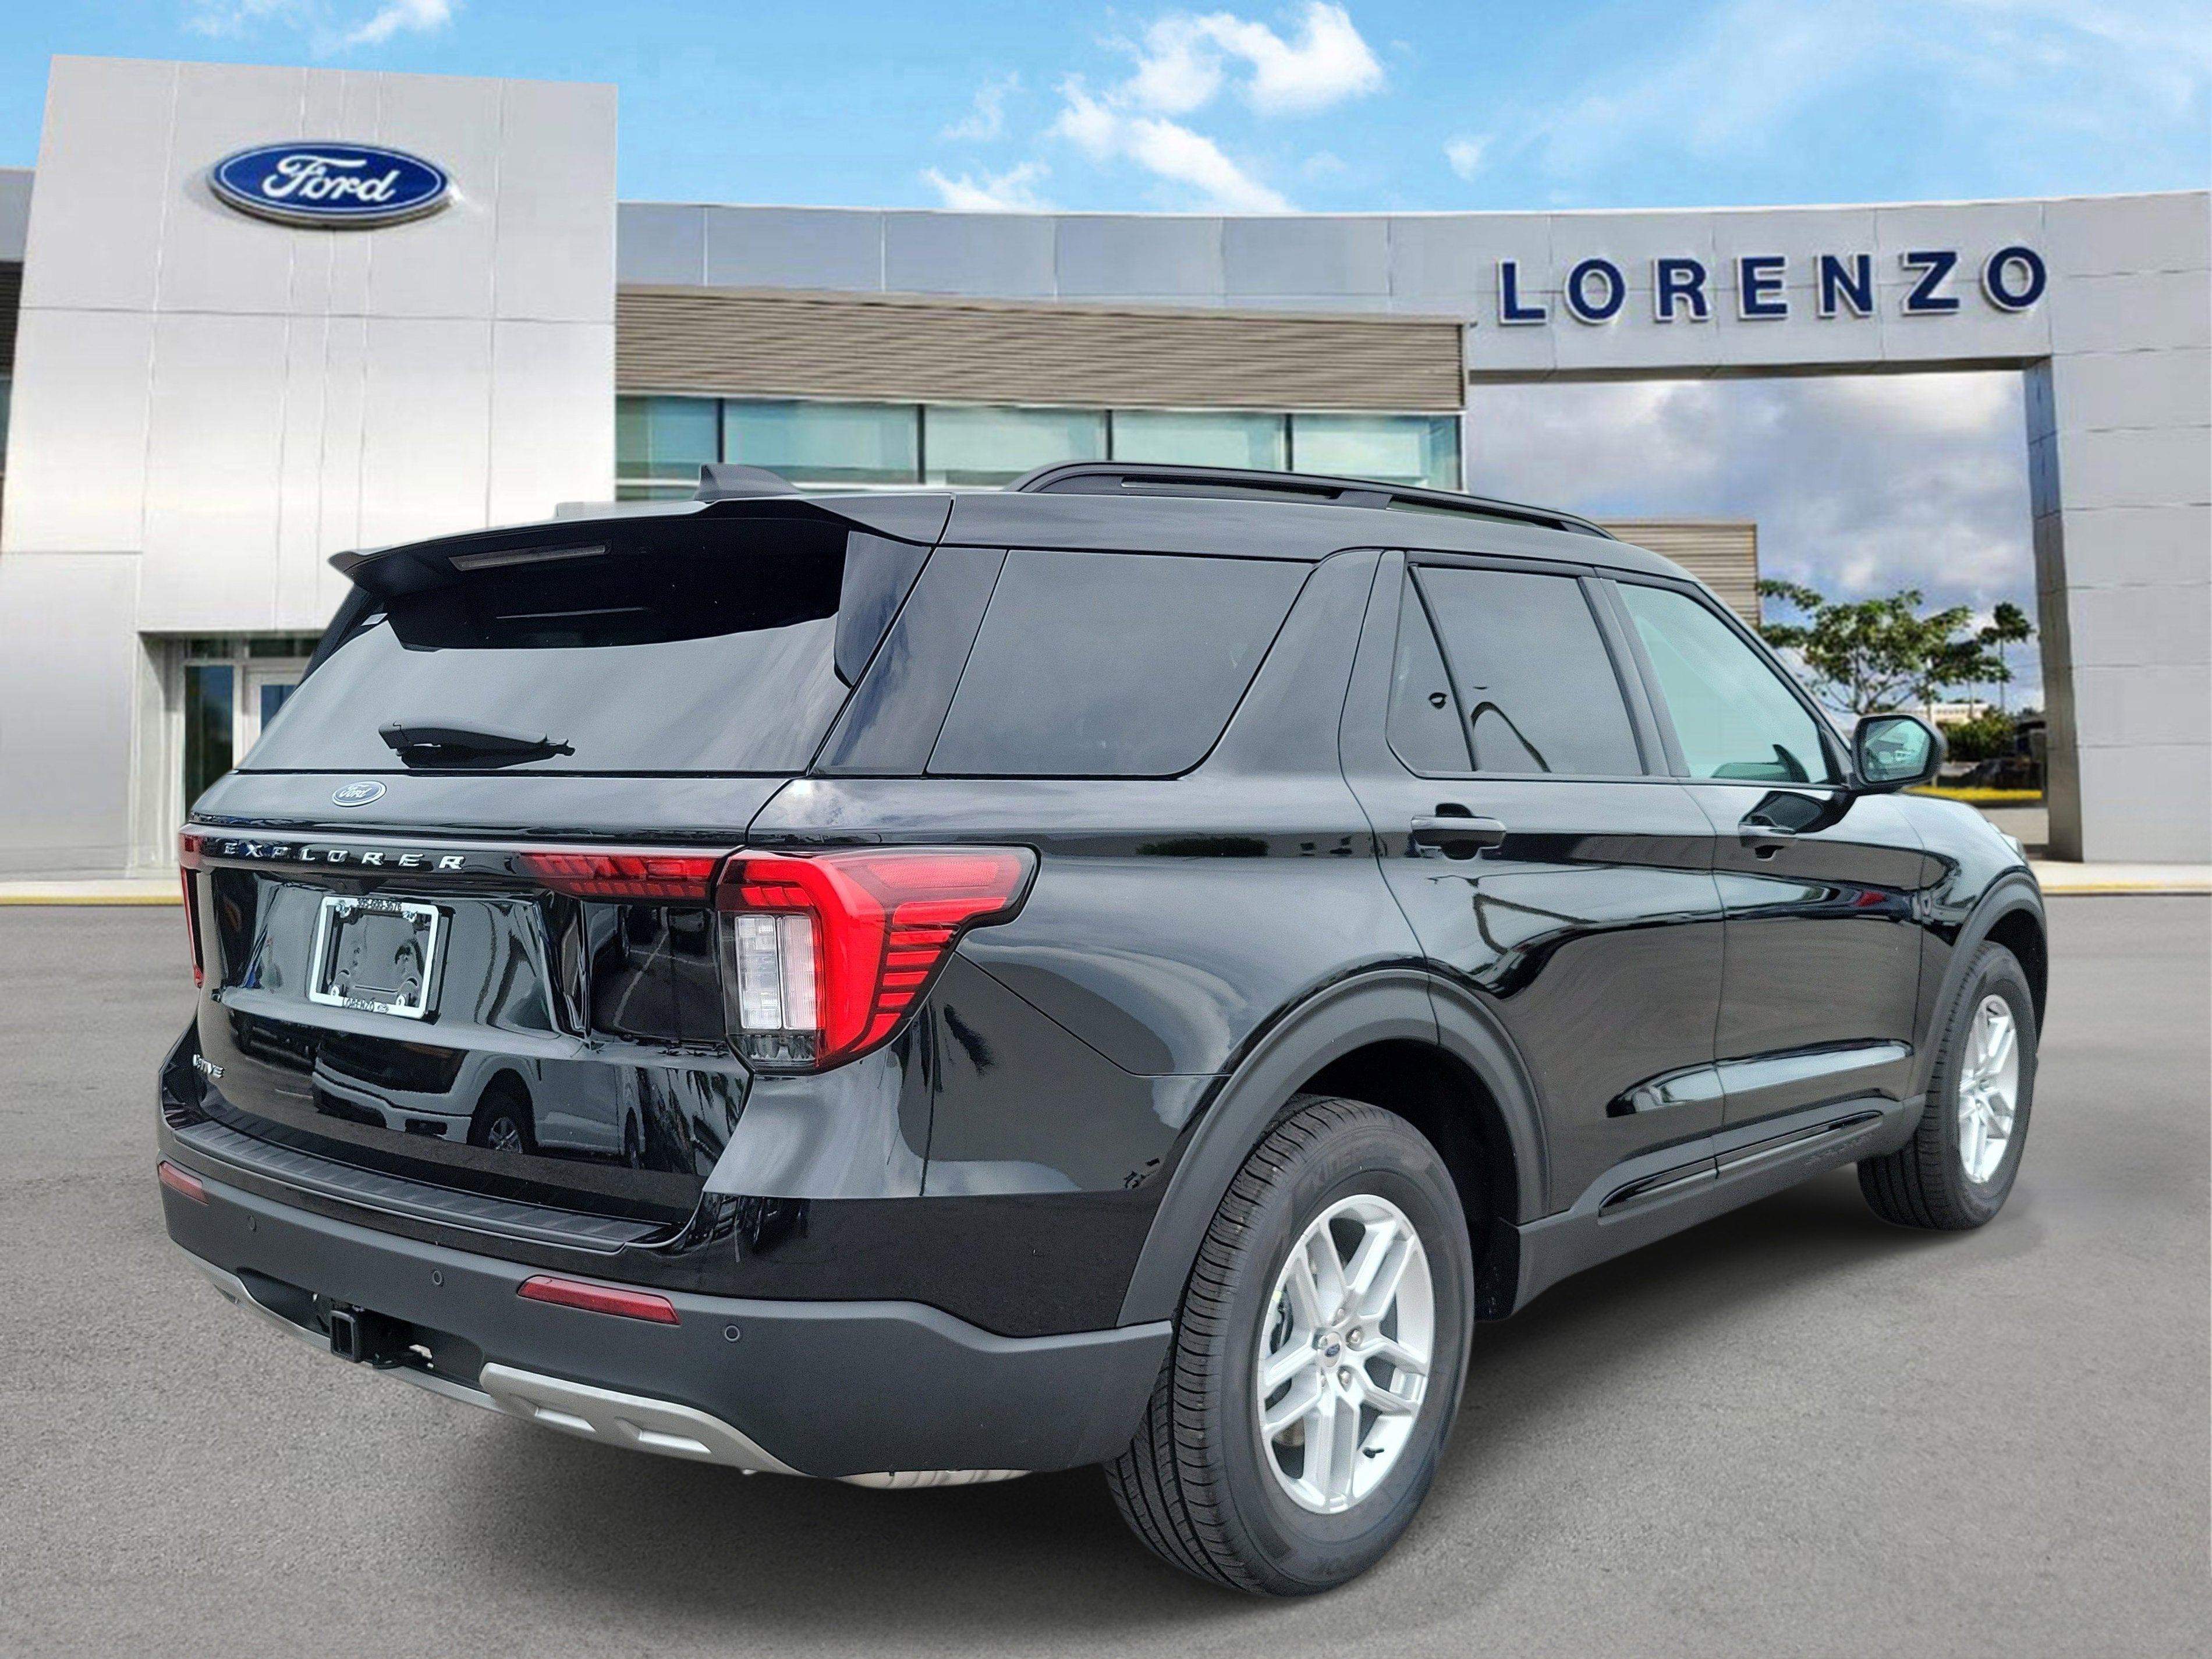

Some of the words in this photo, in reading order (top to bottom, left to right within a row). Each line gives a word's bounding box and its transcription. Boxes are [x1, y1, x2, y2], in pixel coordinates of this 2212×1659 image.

[262, 154, 401, 201] Ford
[1500, 246, 2047, 324] LORENZO
[338, 784, 373, 798] Ford
[223, 842, 466, 870] EXPLORER
